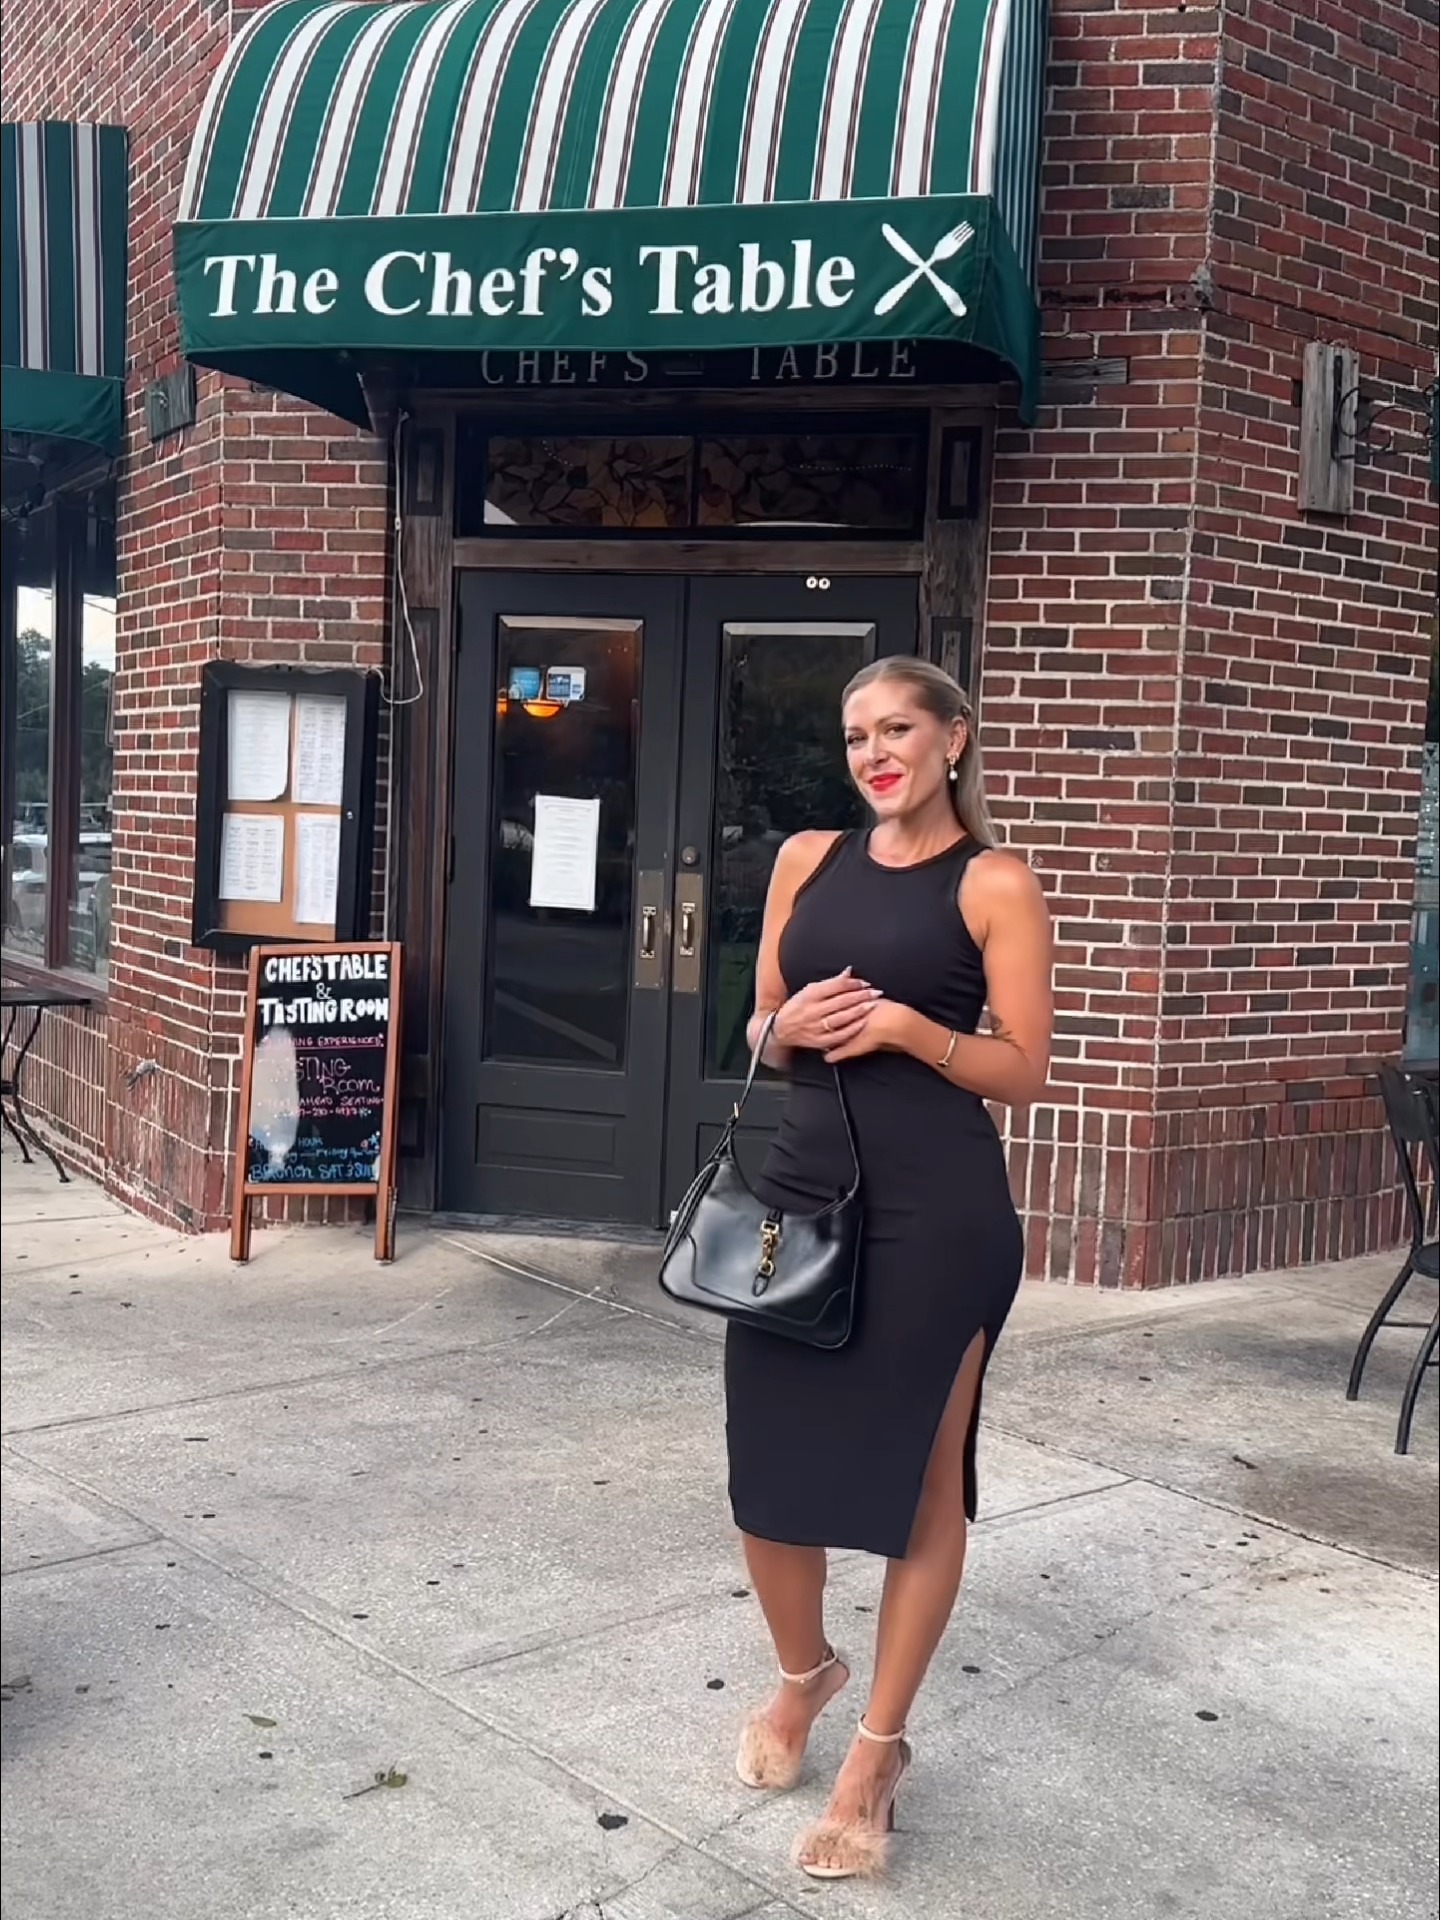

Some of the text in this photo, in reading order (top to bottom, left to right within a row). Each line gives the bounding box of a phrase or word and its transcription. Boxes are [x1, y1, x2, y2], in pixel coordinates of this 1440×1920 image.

[203, 239, 856, 317] The Chef's Table
[323, 953, 388, 981] TABLE
[316, 982, 332, 1000] &
[257, 997, 389, 1025] TASTING ROOM
